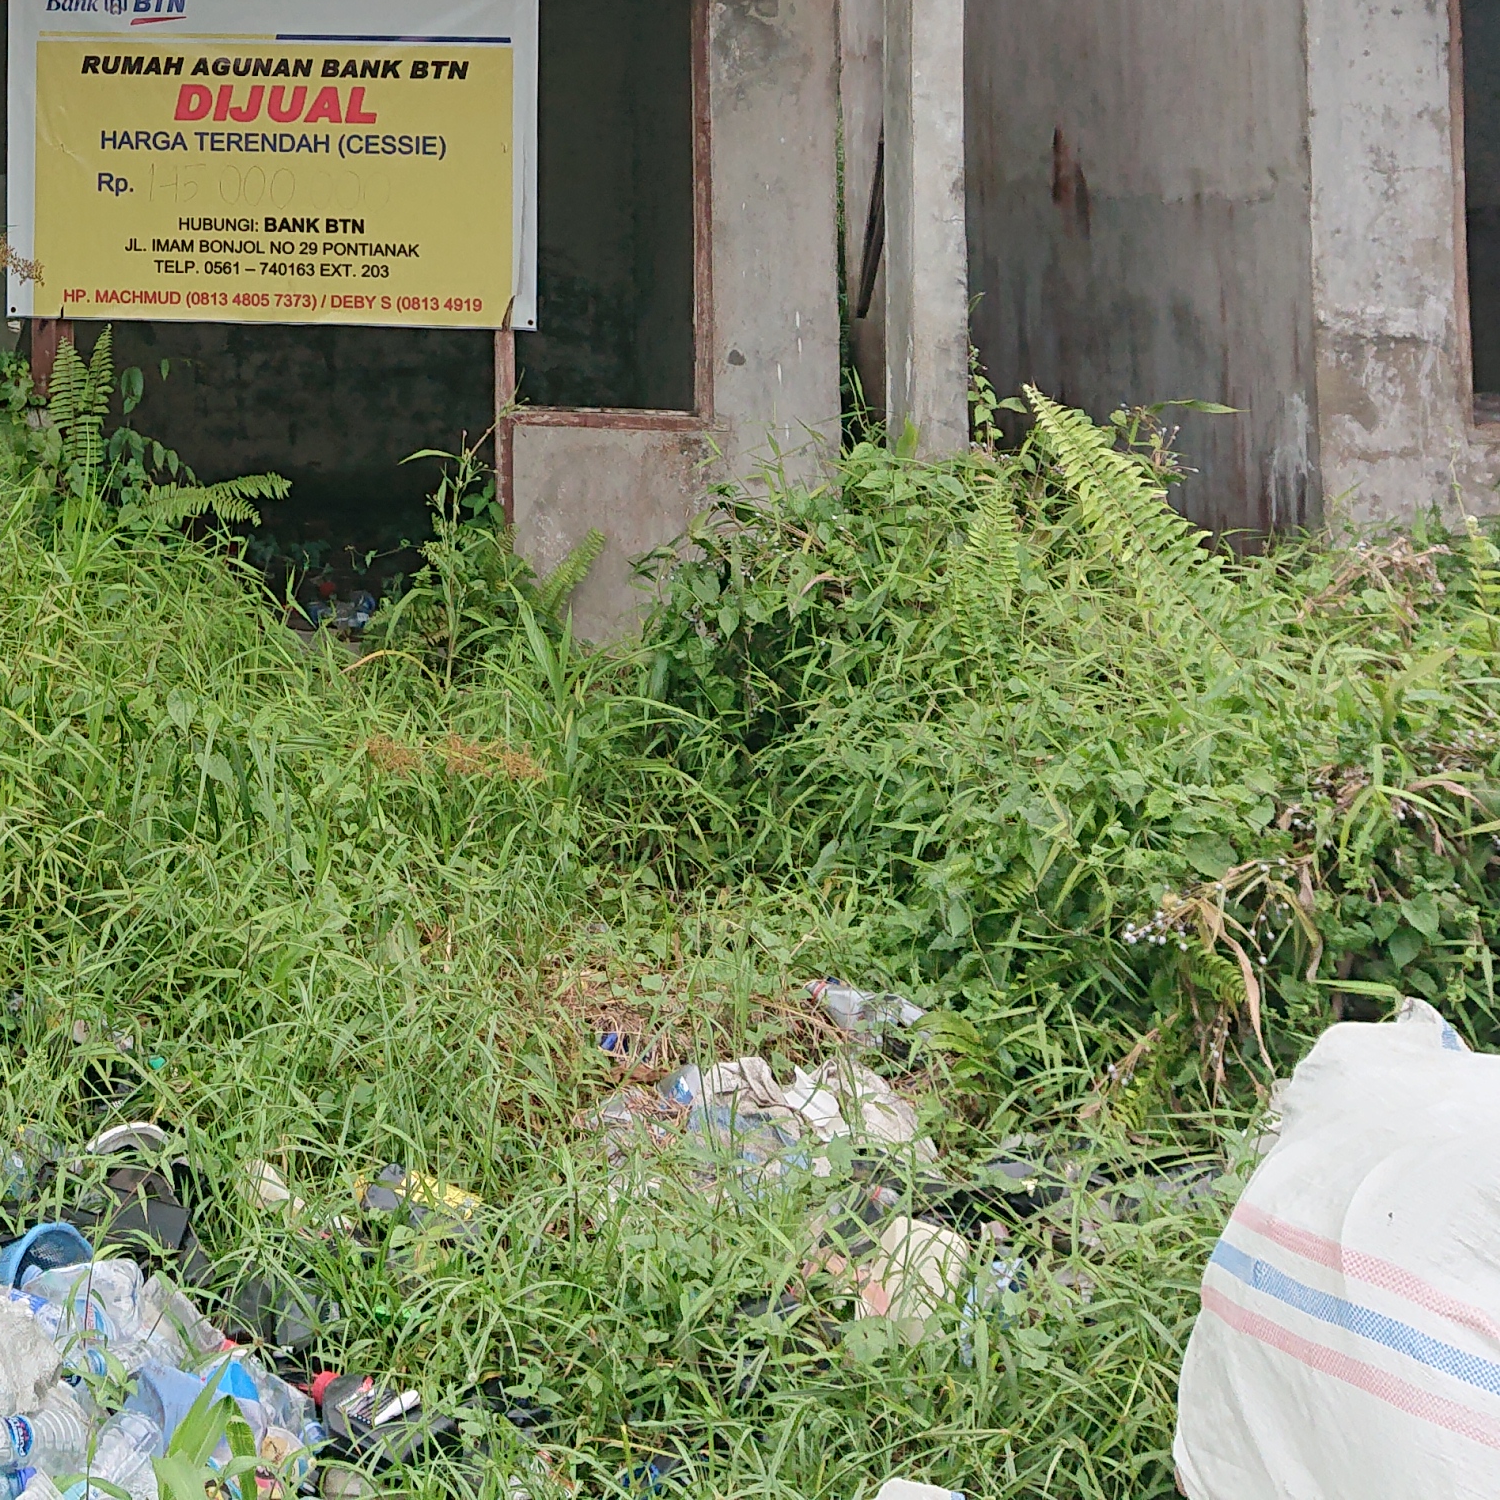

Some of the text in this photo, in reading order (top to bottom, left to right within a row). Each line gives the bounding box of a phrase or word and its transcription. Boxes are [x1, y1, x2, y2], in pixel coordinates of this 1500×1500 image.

[81, 55, 469, 80] RUMAH AGUNAN BANK BTN
[174, 84, 377, 124] DIJUAL
[101, 130, 447, 160] HARGA TERENDAH (CESSIE)
[97, 173, 134, 197] Rp.
[179, 216, 365, 235] HUBUNGI: BANK BTN
[125, 238, 420, 258] JL. IMAM BONJOL NO 29 PONTIANAK
[154, 260, 200, 275] TELP.
[205, 261, 240, 275] 0561
[260, 262, 316, 277] 740163
[320, 263, 357, 278] EXT.
[361, 264, 390, 279] 203
[63, 289, 483, 313] HP. MACHMUD (0813 4805 7373) / DEBY S (0813 4919
